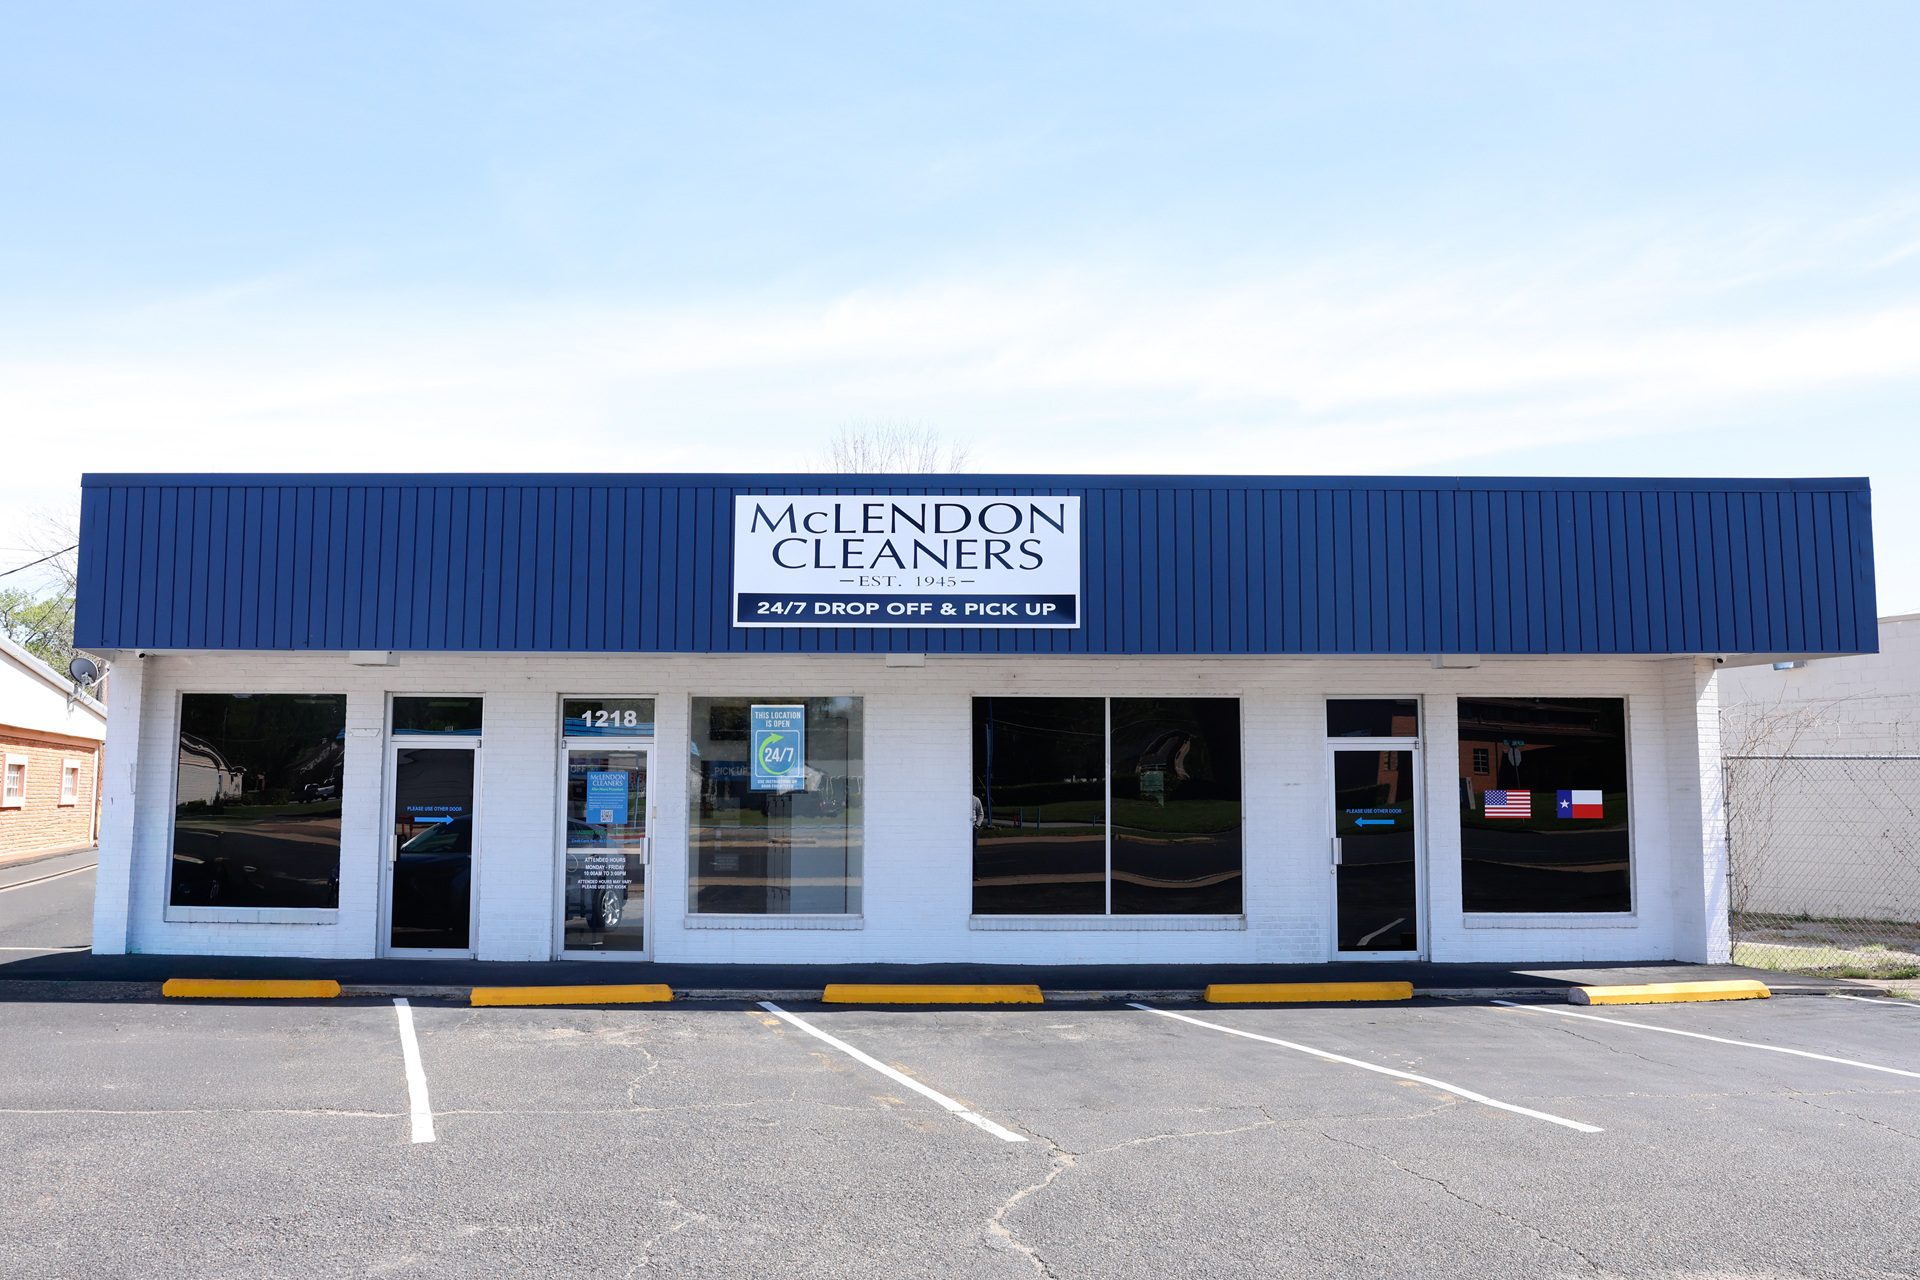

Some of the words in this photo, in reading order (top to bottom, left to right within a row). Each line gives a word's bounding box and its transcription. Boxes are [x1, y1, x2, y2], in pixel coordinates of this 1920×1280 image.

[750, 502, 1066, 535] McLENDON
[772, 538, 1044, 570] CLEANERS
[916, 575, 957, 587] 1945
[757, 601, 807, 615] 24/7
[814, 602, 880, 615] DROP
[886, 602, 933, 616] OFF
[940, 602, 957, 616] &
[965, 602, 1018, 616] PICK
[1025, 602, 1057, 616] UP
[581, 710, 637, 727] 1218
[755, 711, 769, 719] THIS
[771, 711, 801, 719] LOCATION
[764, 747, 794, 762] 24/7
[715, 767, 735, 776] PICK
[736, 767, 748, 776] UP
